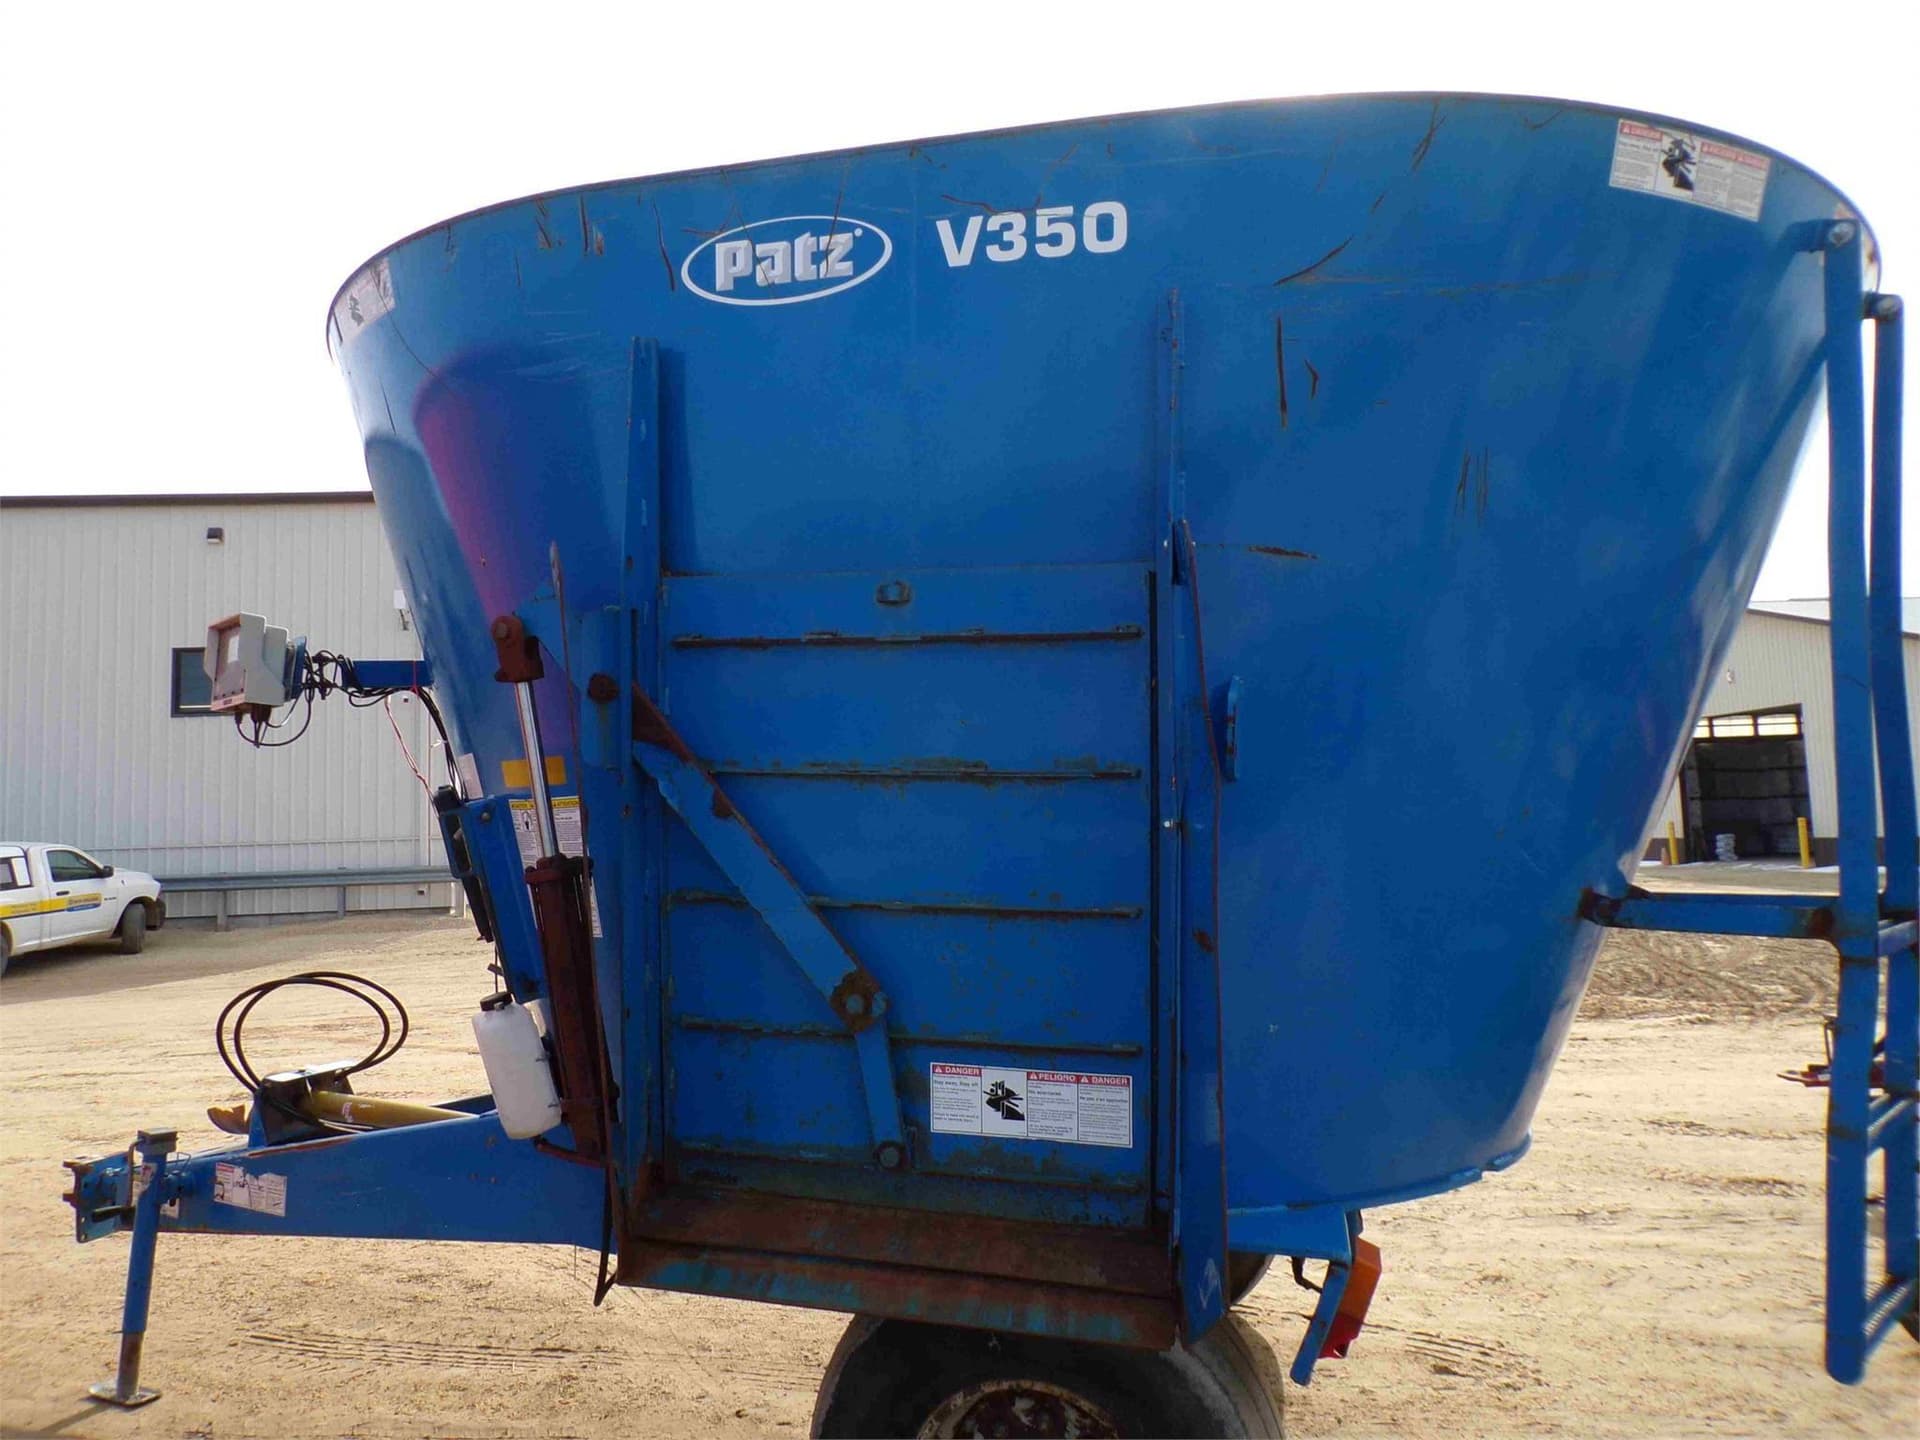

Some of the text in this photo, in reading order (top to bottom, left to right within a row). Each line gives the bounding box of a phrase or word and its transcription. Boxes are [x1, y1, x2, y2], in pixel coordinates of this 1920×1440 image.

[935, 201, 1128, 267] V350
[715, 231, 855, 292] Patz
[945, 1066, 979, 1076] DANGER
[1038, 1072, 1077, 1082] PELIGRO
[1091, 1076, 1128, 1085] DANGER
